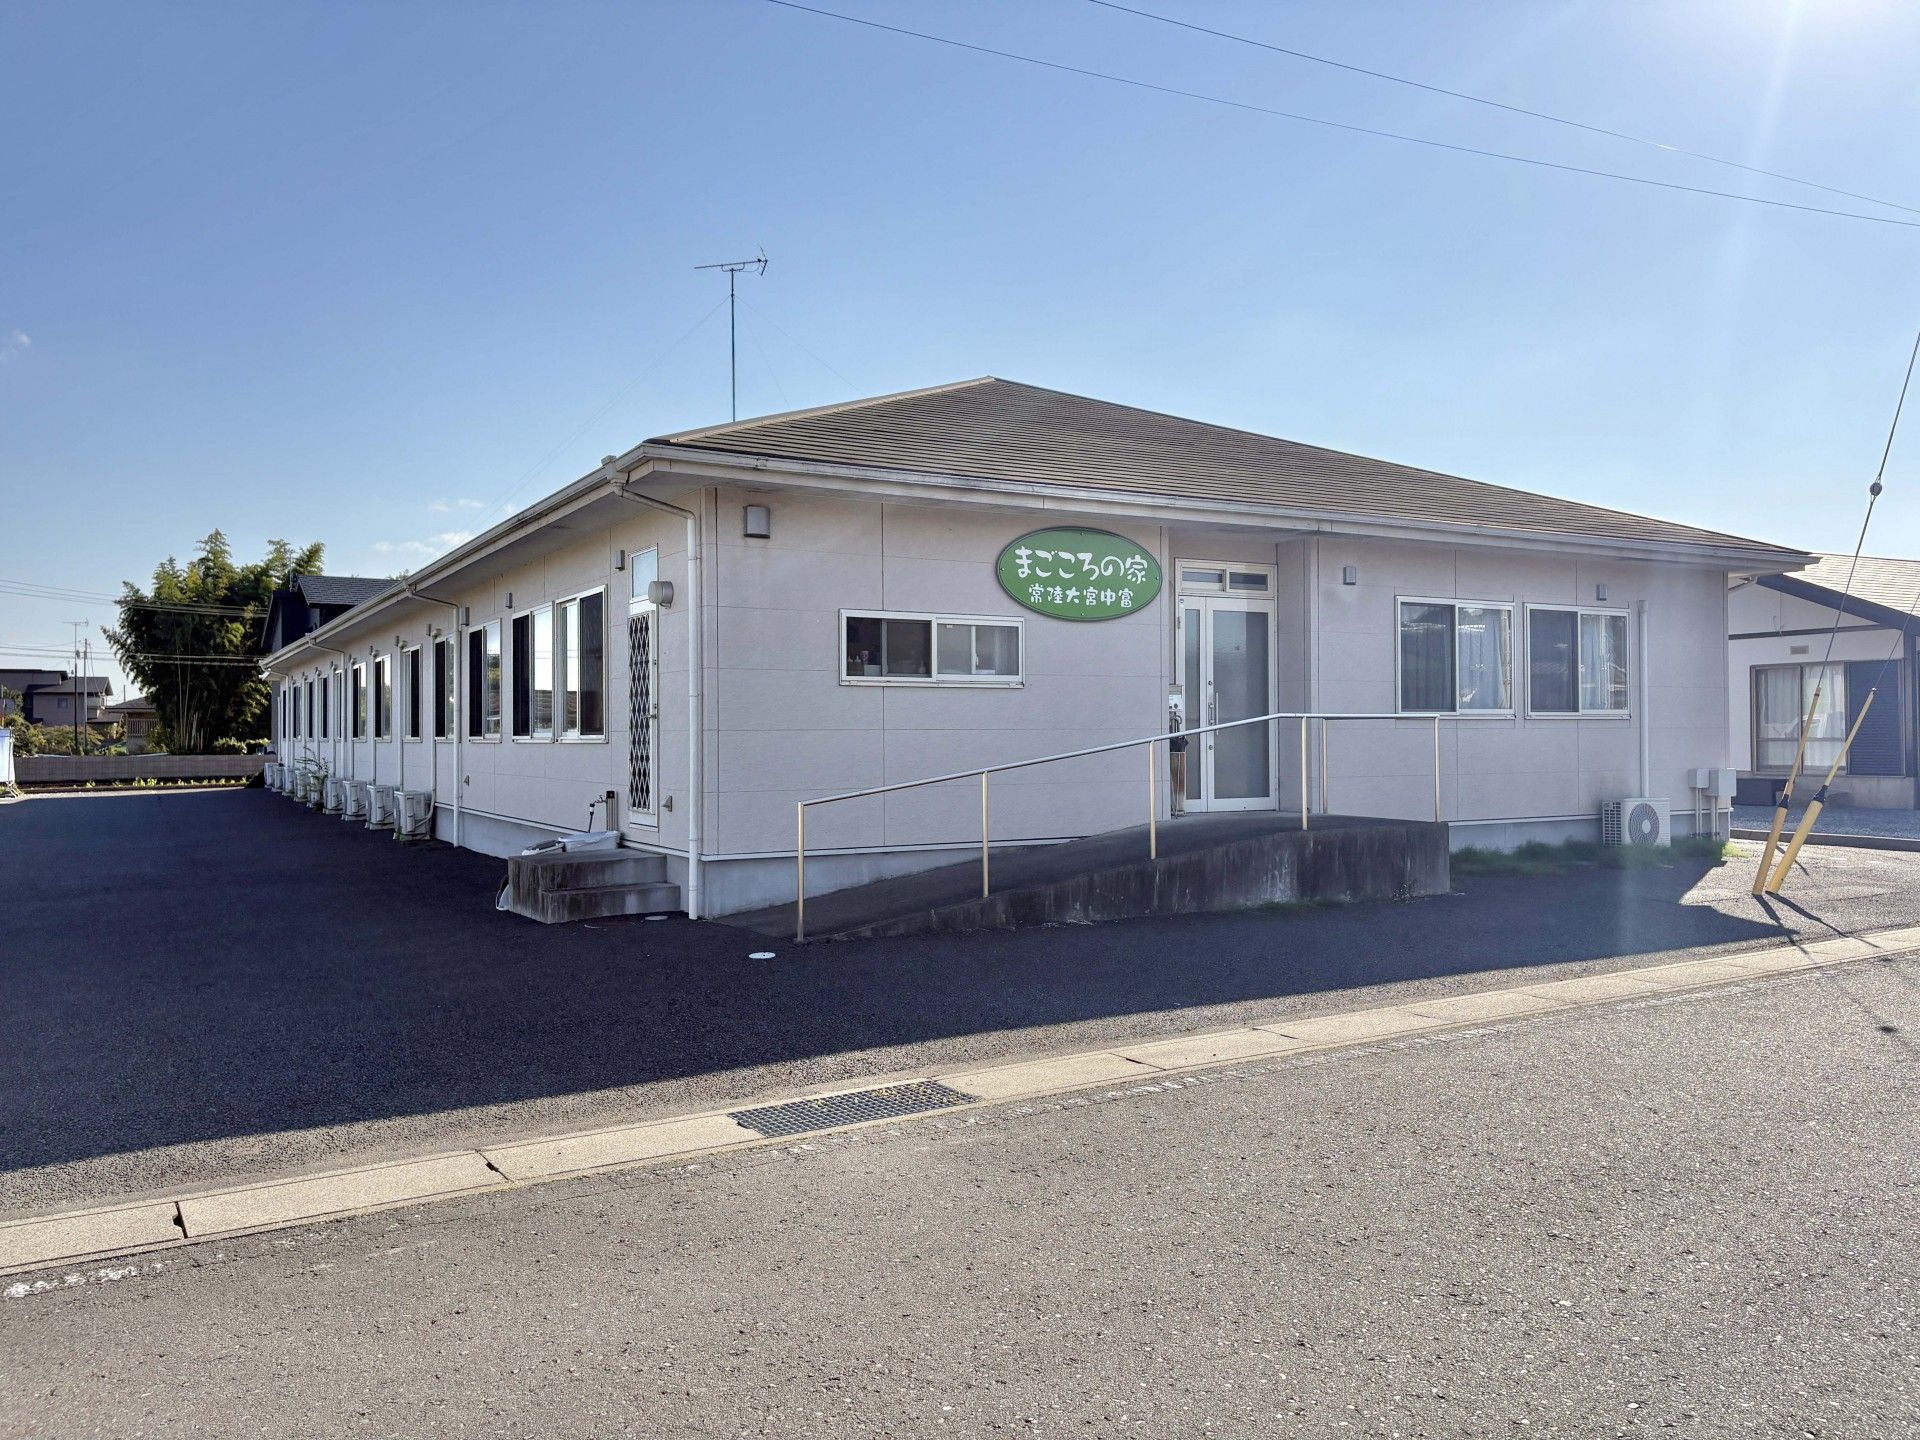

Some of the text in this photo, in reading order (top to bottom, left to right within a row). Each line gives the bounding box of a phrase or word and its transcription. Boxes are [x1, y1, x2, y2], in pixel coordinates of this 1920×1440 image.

[1015, 546, 1148, 584] まごころの家
[1029, 583, 1133, 608] 常陸大宮中富
